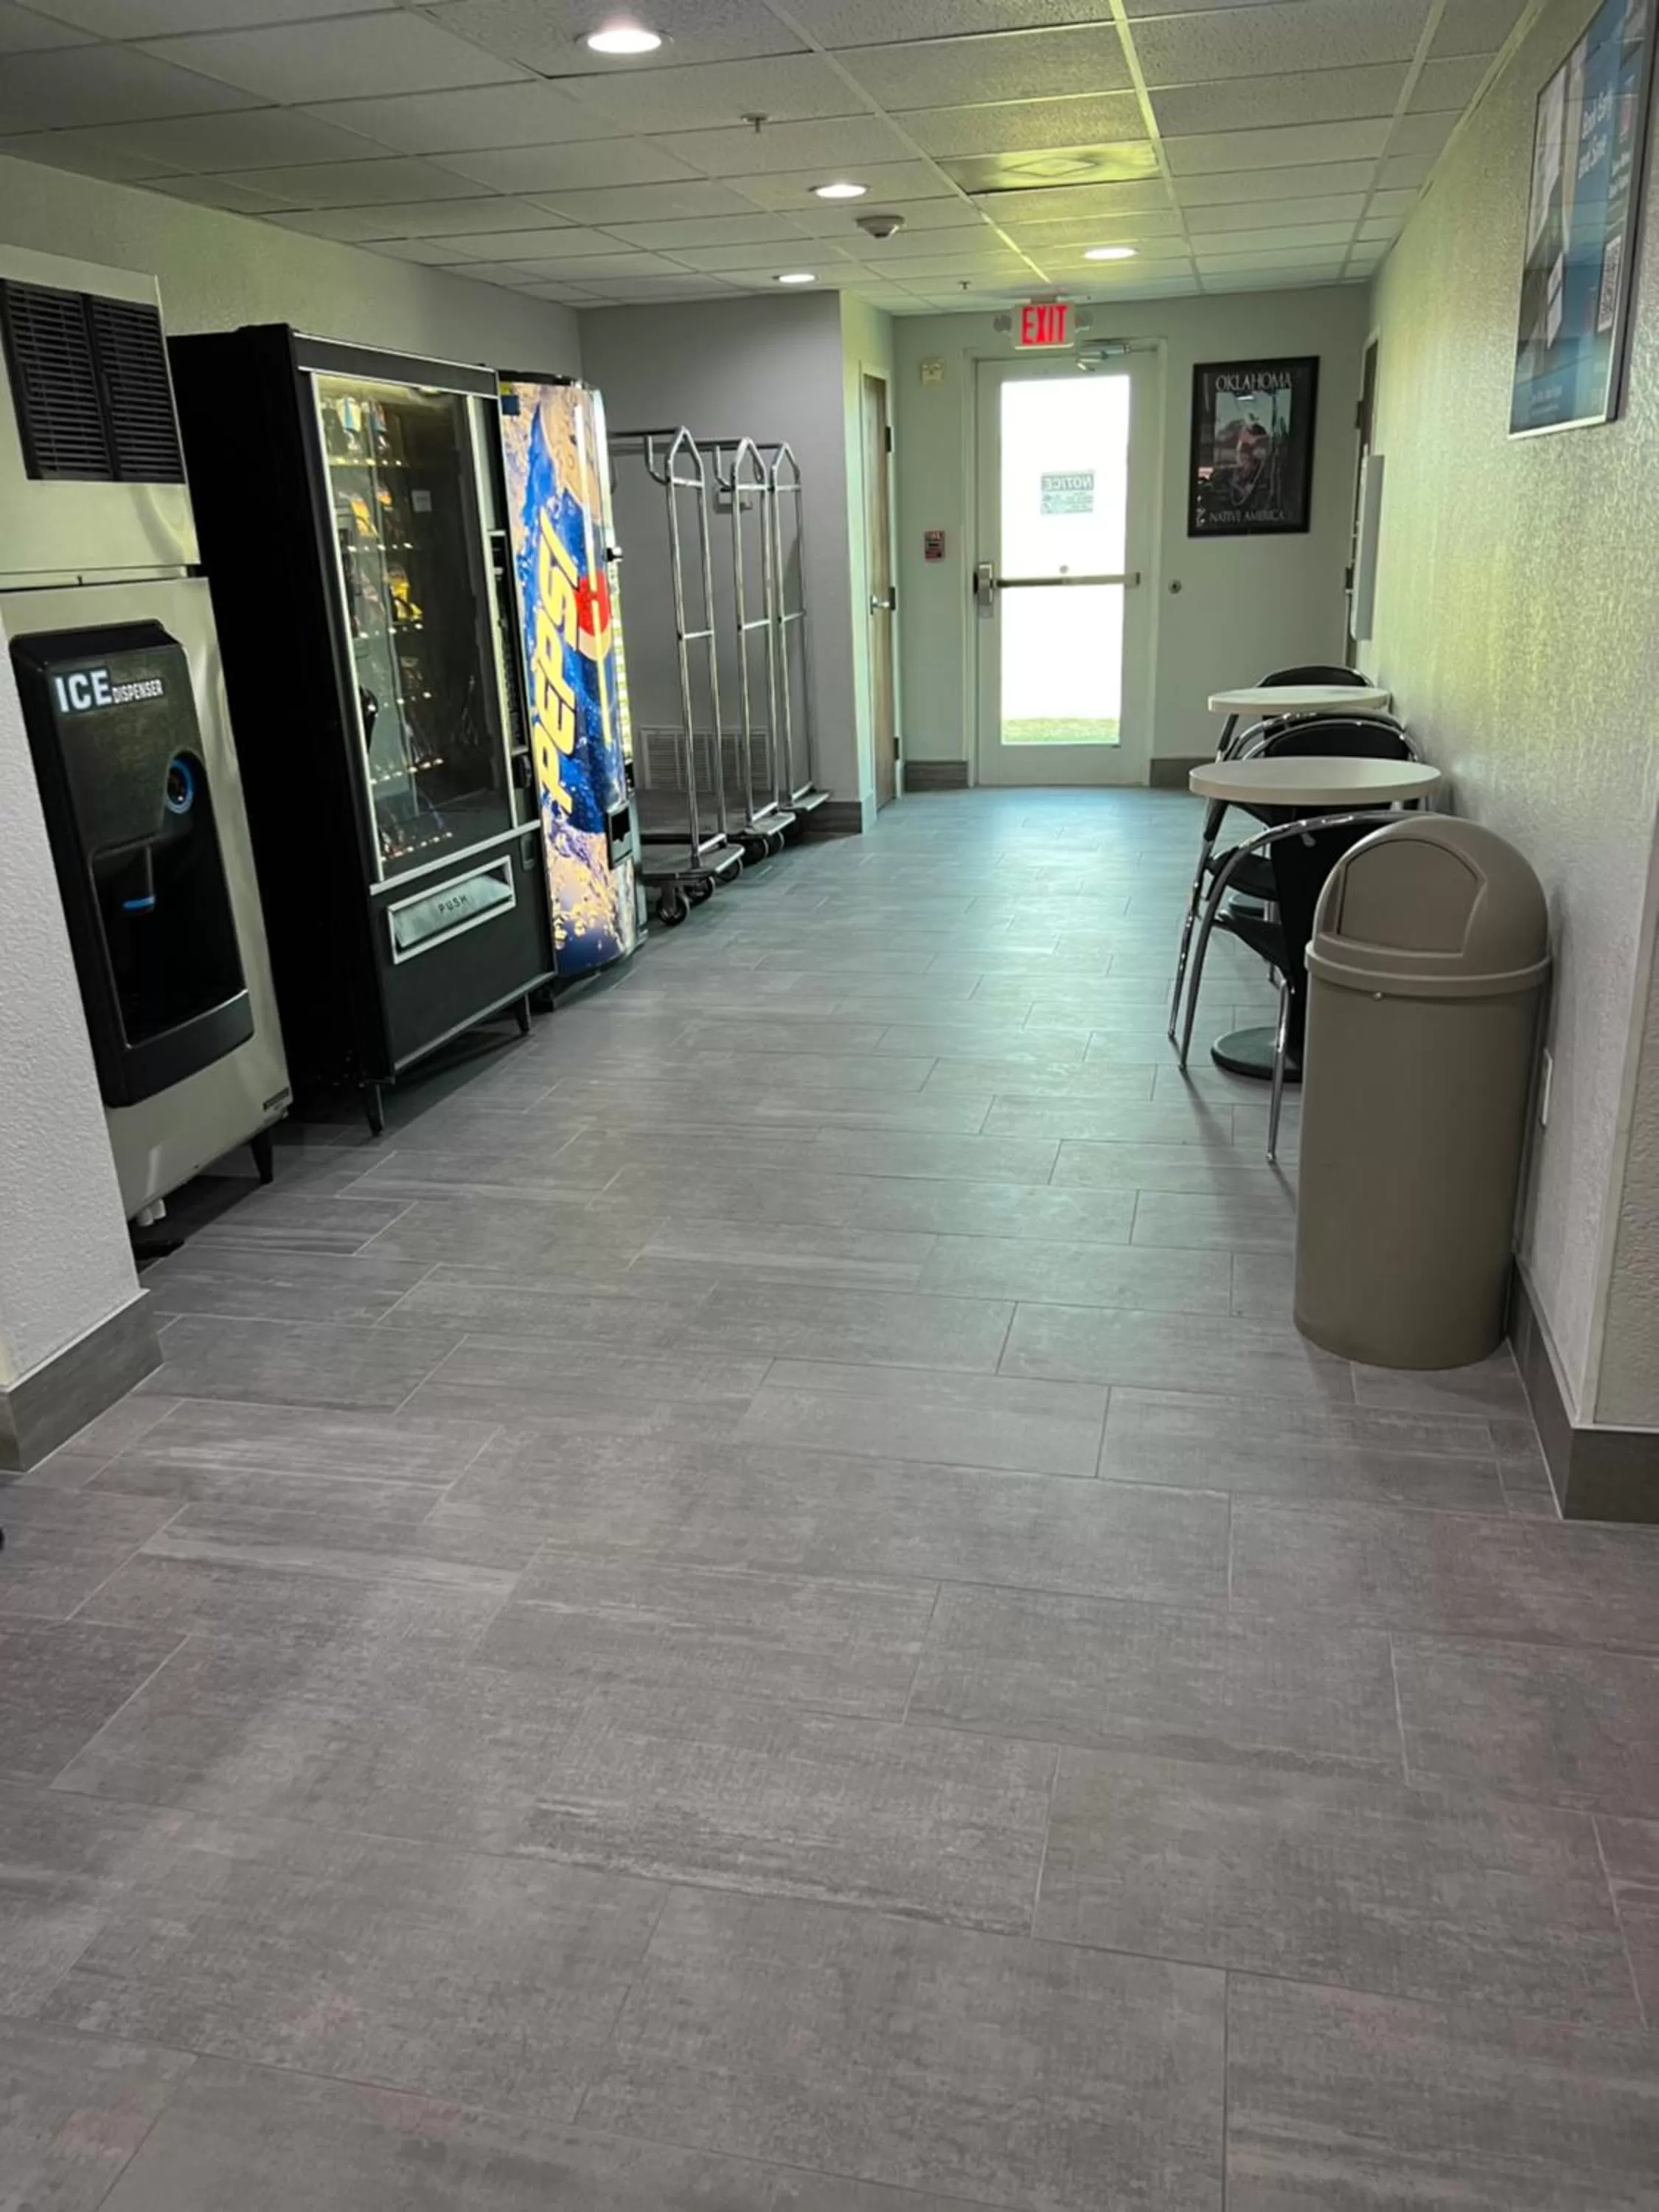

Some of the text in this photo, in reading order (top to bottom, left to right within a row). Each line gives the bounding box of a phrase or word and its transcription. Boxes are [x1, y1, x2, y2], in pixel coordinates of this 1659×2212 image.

[1022, 305, 1067, 345] EXIT
[1216, 371, 1292, 391] OKLAHOMA
[1209, 509, 1285, 523] NATIVE AMERICA
[533, 506, 579, 814] PEPSI
[54, 669, 164, 712] ICE DISPENSER
[437, 894, 467, 913] PUSH
